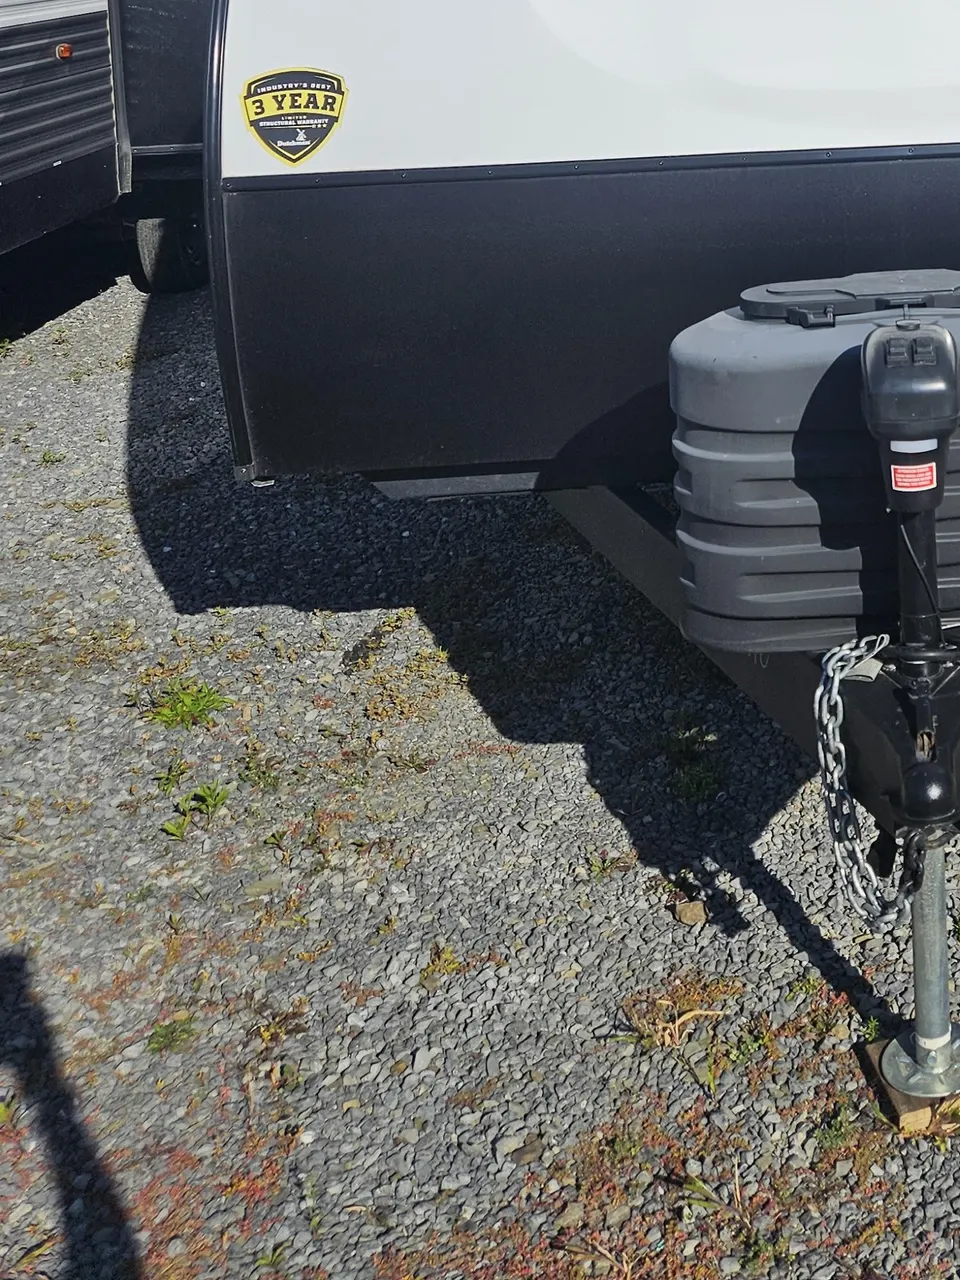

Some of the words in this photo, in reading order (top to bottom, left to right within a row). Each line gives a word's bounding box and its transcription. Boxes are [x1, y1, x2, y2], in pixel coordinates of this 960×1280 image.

[257, 83, 308, 93] INDUSTRY'S
[252, 99, 265, 115] 3
[272, 93, 337, 111] YEAR
